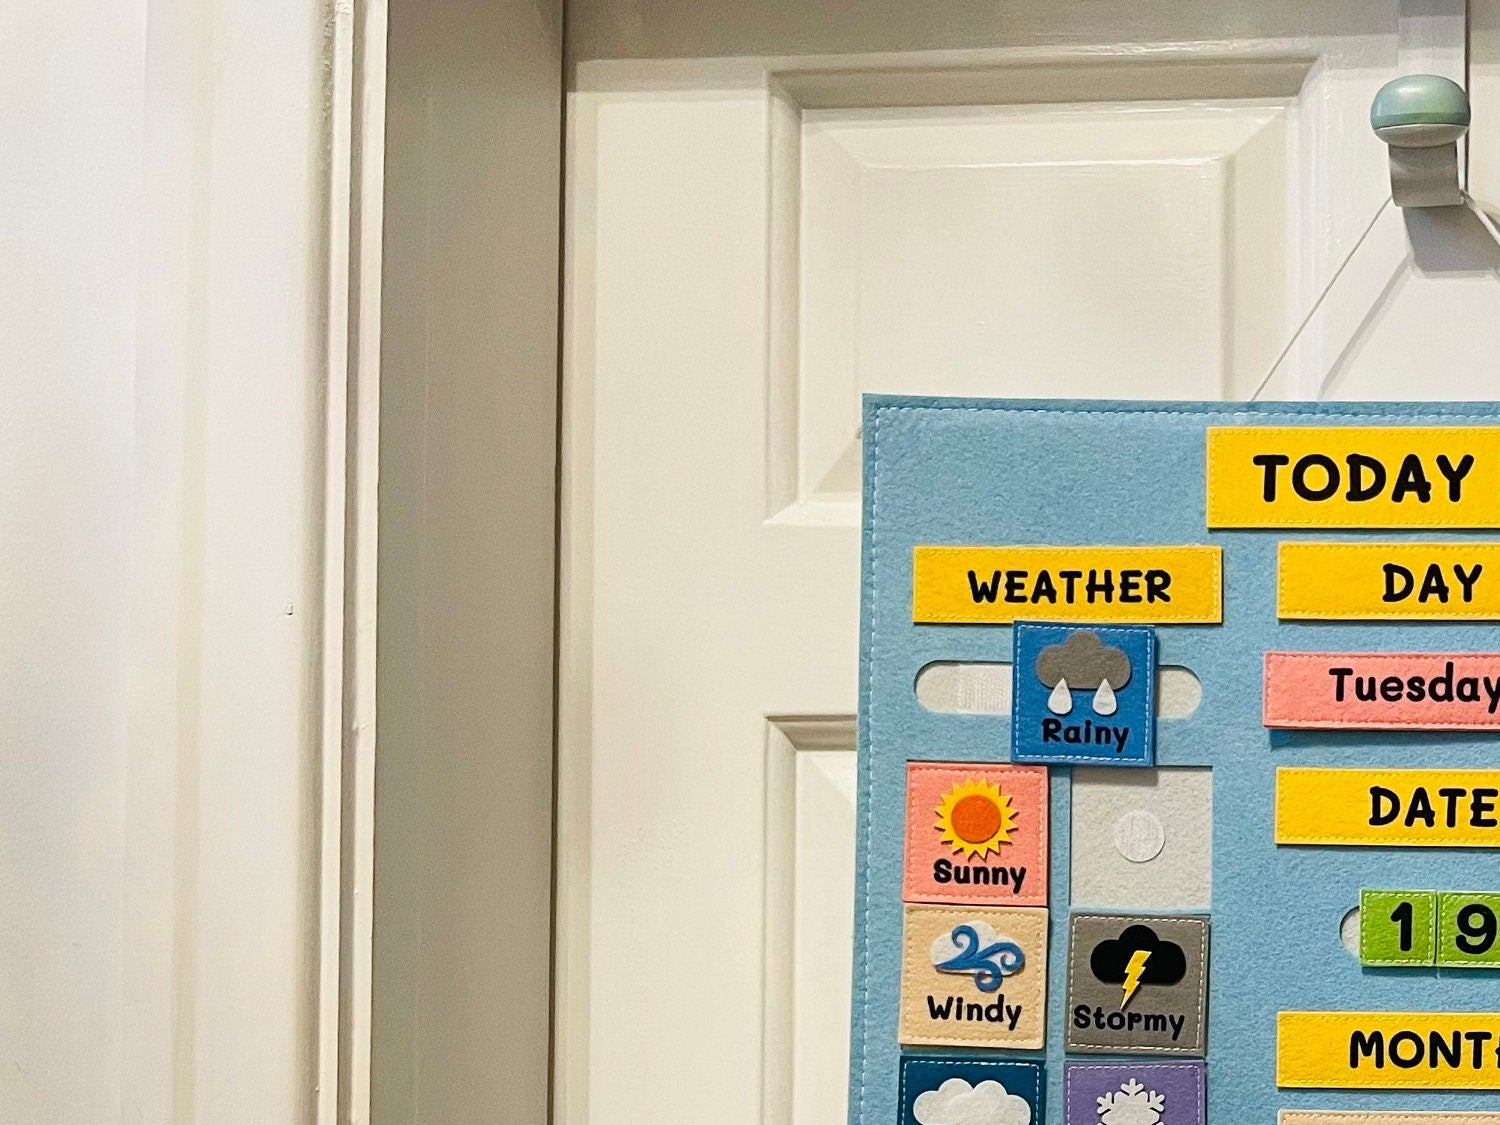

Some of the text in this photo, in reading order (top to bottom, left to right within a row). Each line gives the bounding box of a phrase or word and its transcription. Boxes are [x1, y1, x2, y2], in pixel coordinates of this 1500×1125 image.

[1253, 454, 1474, 503] TODAY
[968, 570, 1171, 603] WEATHER
[1383, 563, 1482, 603] DAY
[1042, 718, 1128, 753] Rainy
[1369, 786, 1498, 827] DATE
[934, 859, 1026, 894] Sunny
[927, 993, 1022, 1031] Windy
[1074, 1004, 1184, 1041] Stormy
